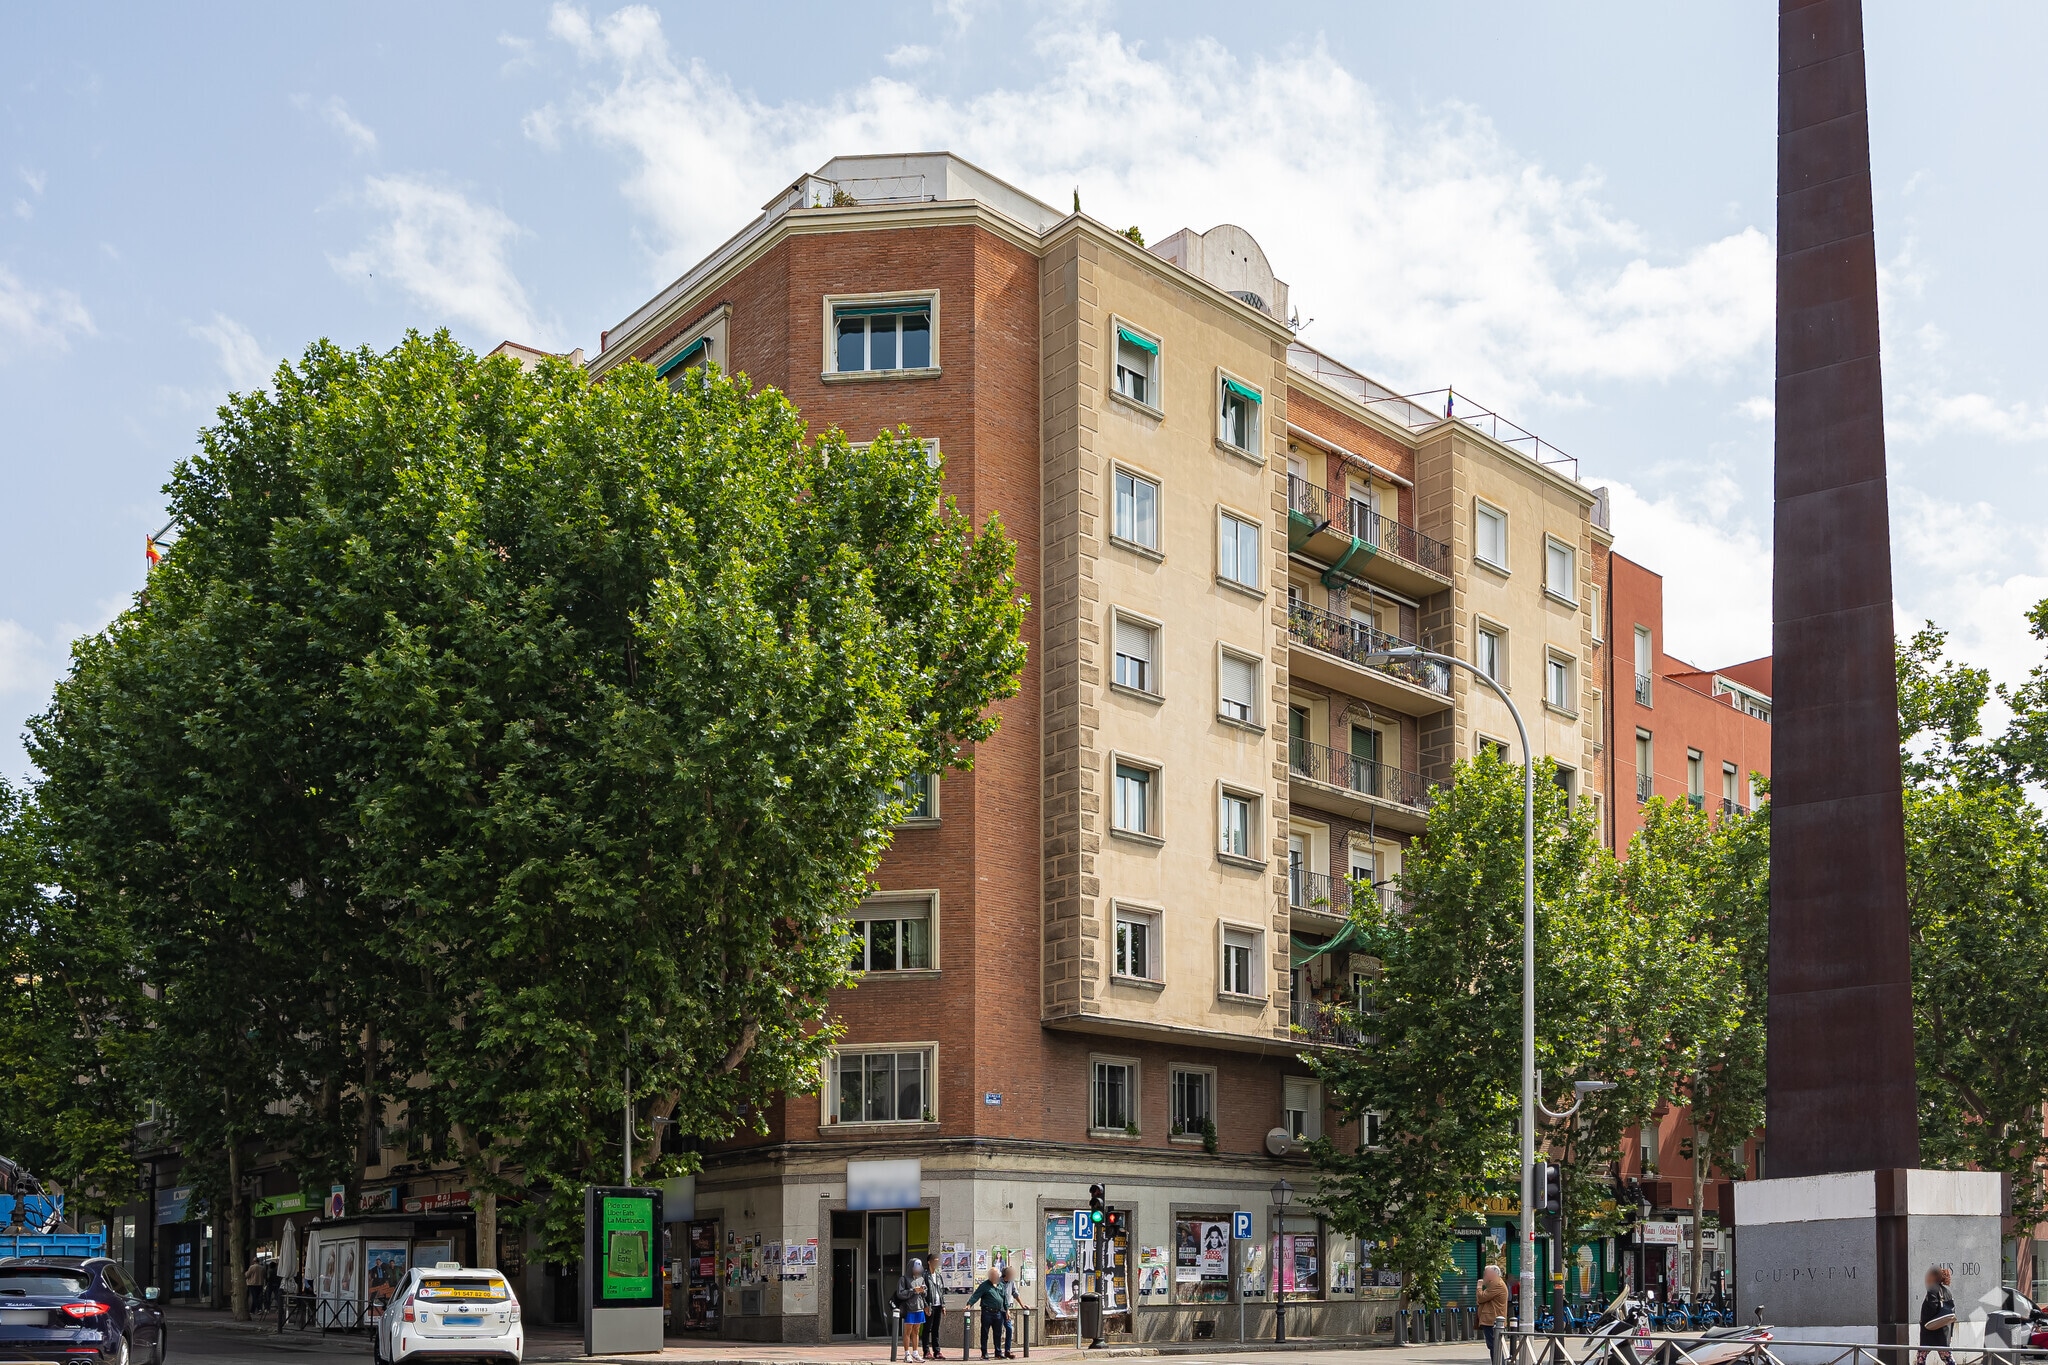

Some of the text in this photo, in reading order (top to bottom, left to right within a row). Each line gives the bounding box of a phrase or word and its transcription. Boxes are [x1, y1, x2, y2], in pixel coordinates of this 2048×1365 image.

[1078, 1213, 1088, 1237] P
[1238, 1215, 1249, 1236] P
[1453, 1228, 1483, 1236] TABERNA
[617, 1255, 632, 1263] Eats
[1962, 1262, 1981, 1276] DEO
